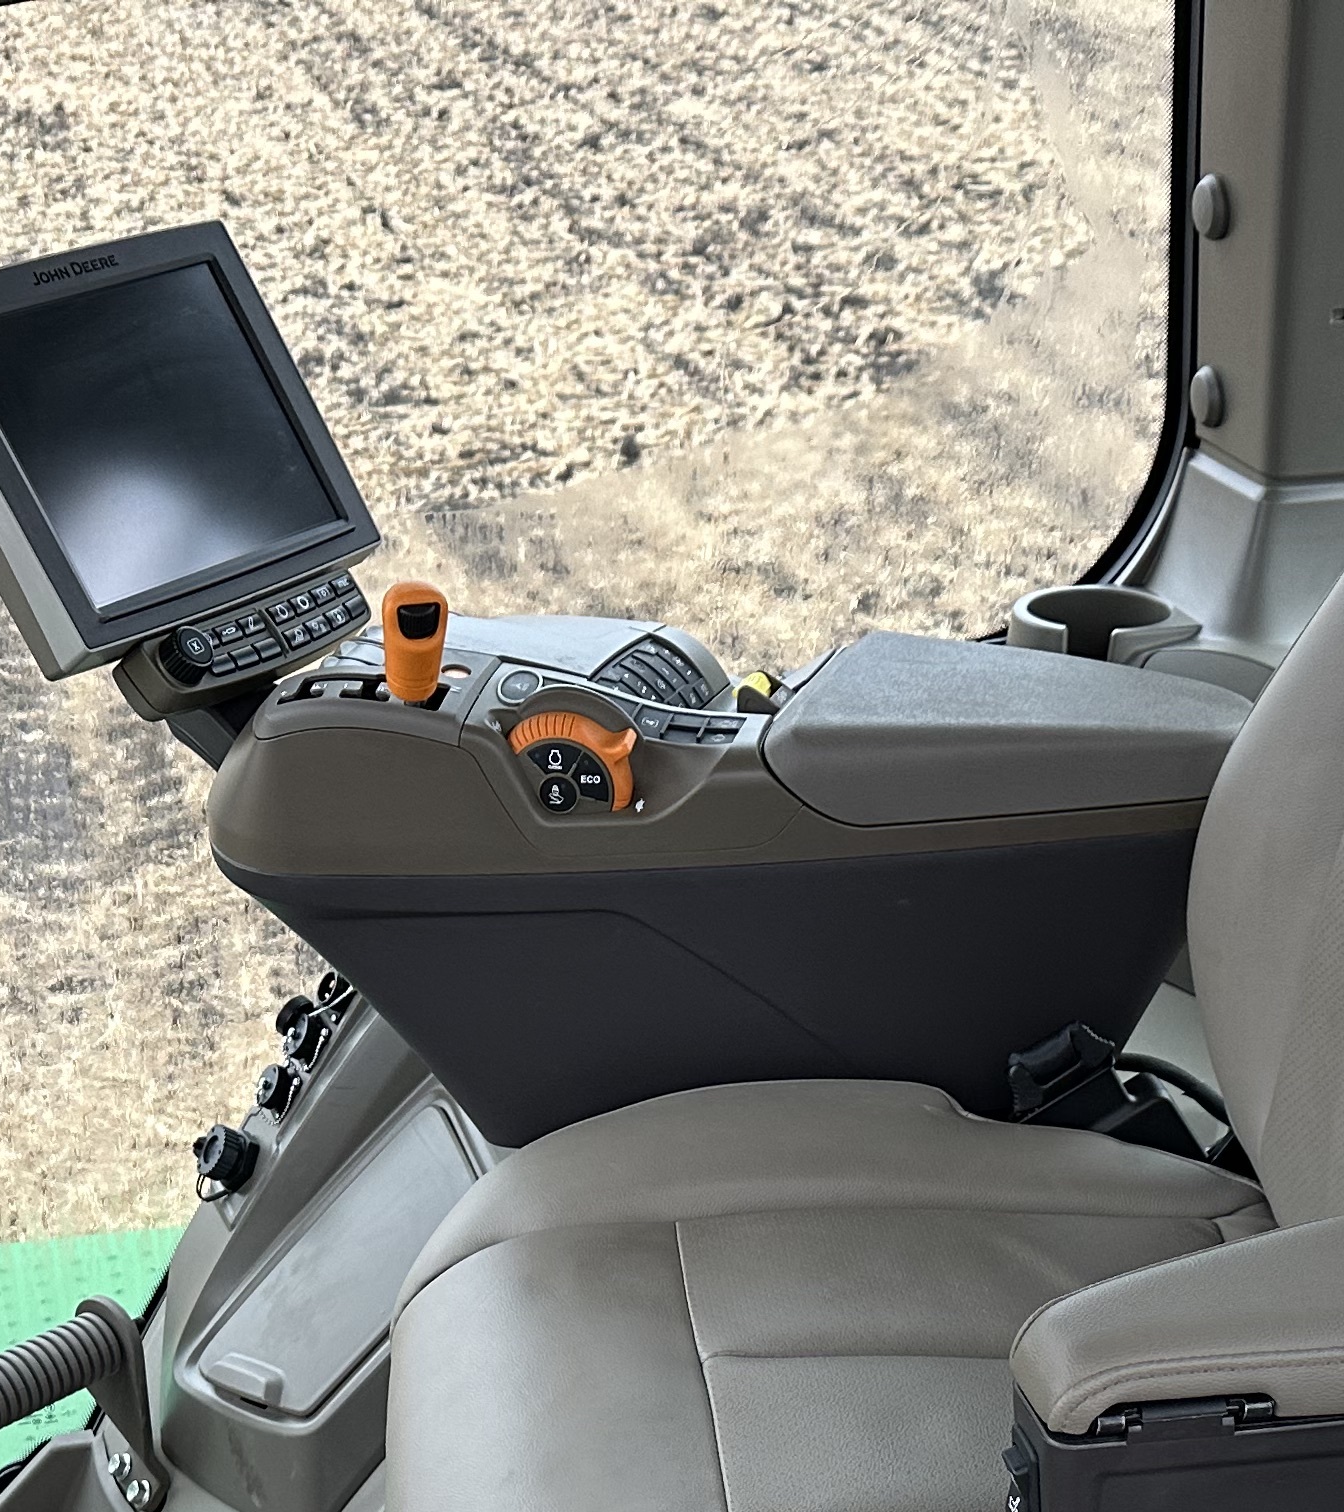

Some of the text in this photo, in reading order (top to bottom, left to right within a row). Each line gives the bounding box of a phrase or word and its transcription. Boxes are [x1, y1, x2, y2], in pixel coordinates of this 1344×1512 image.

[33, 255, 119, 286] JOHN DEERE
[580, 775, 601, 784] ECO
